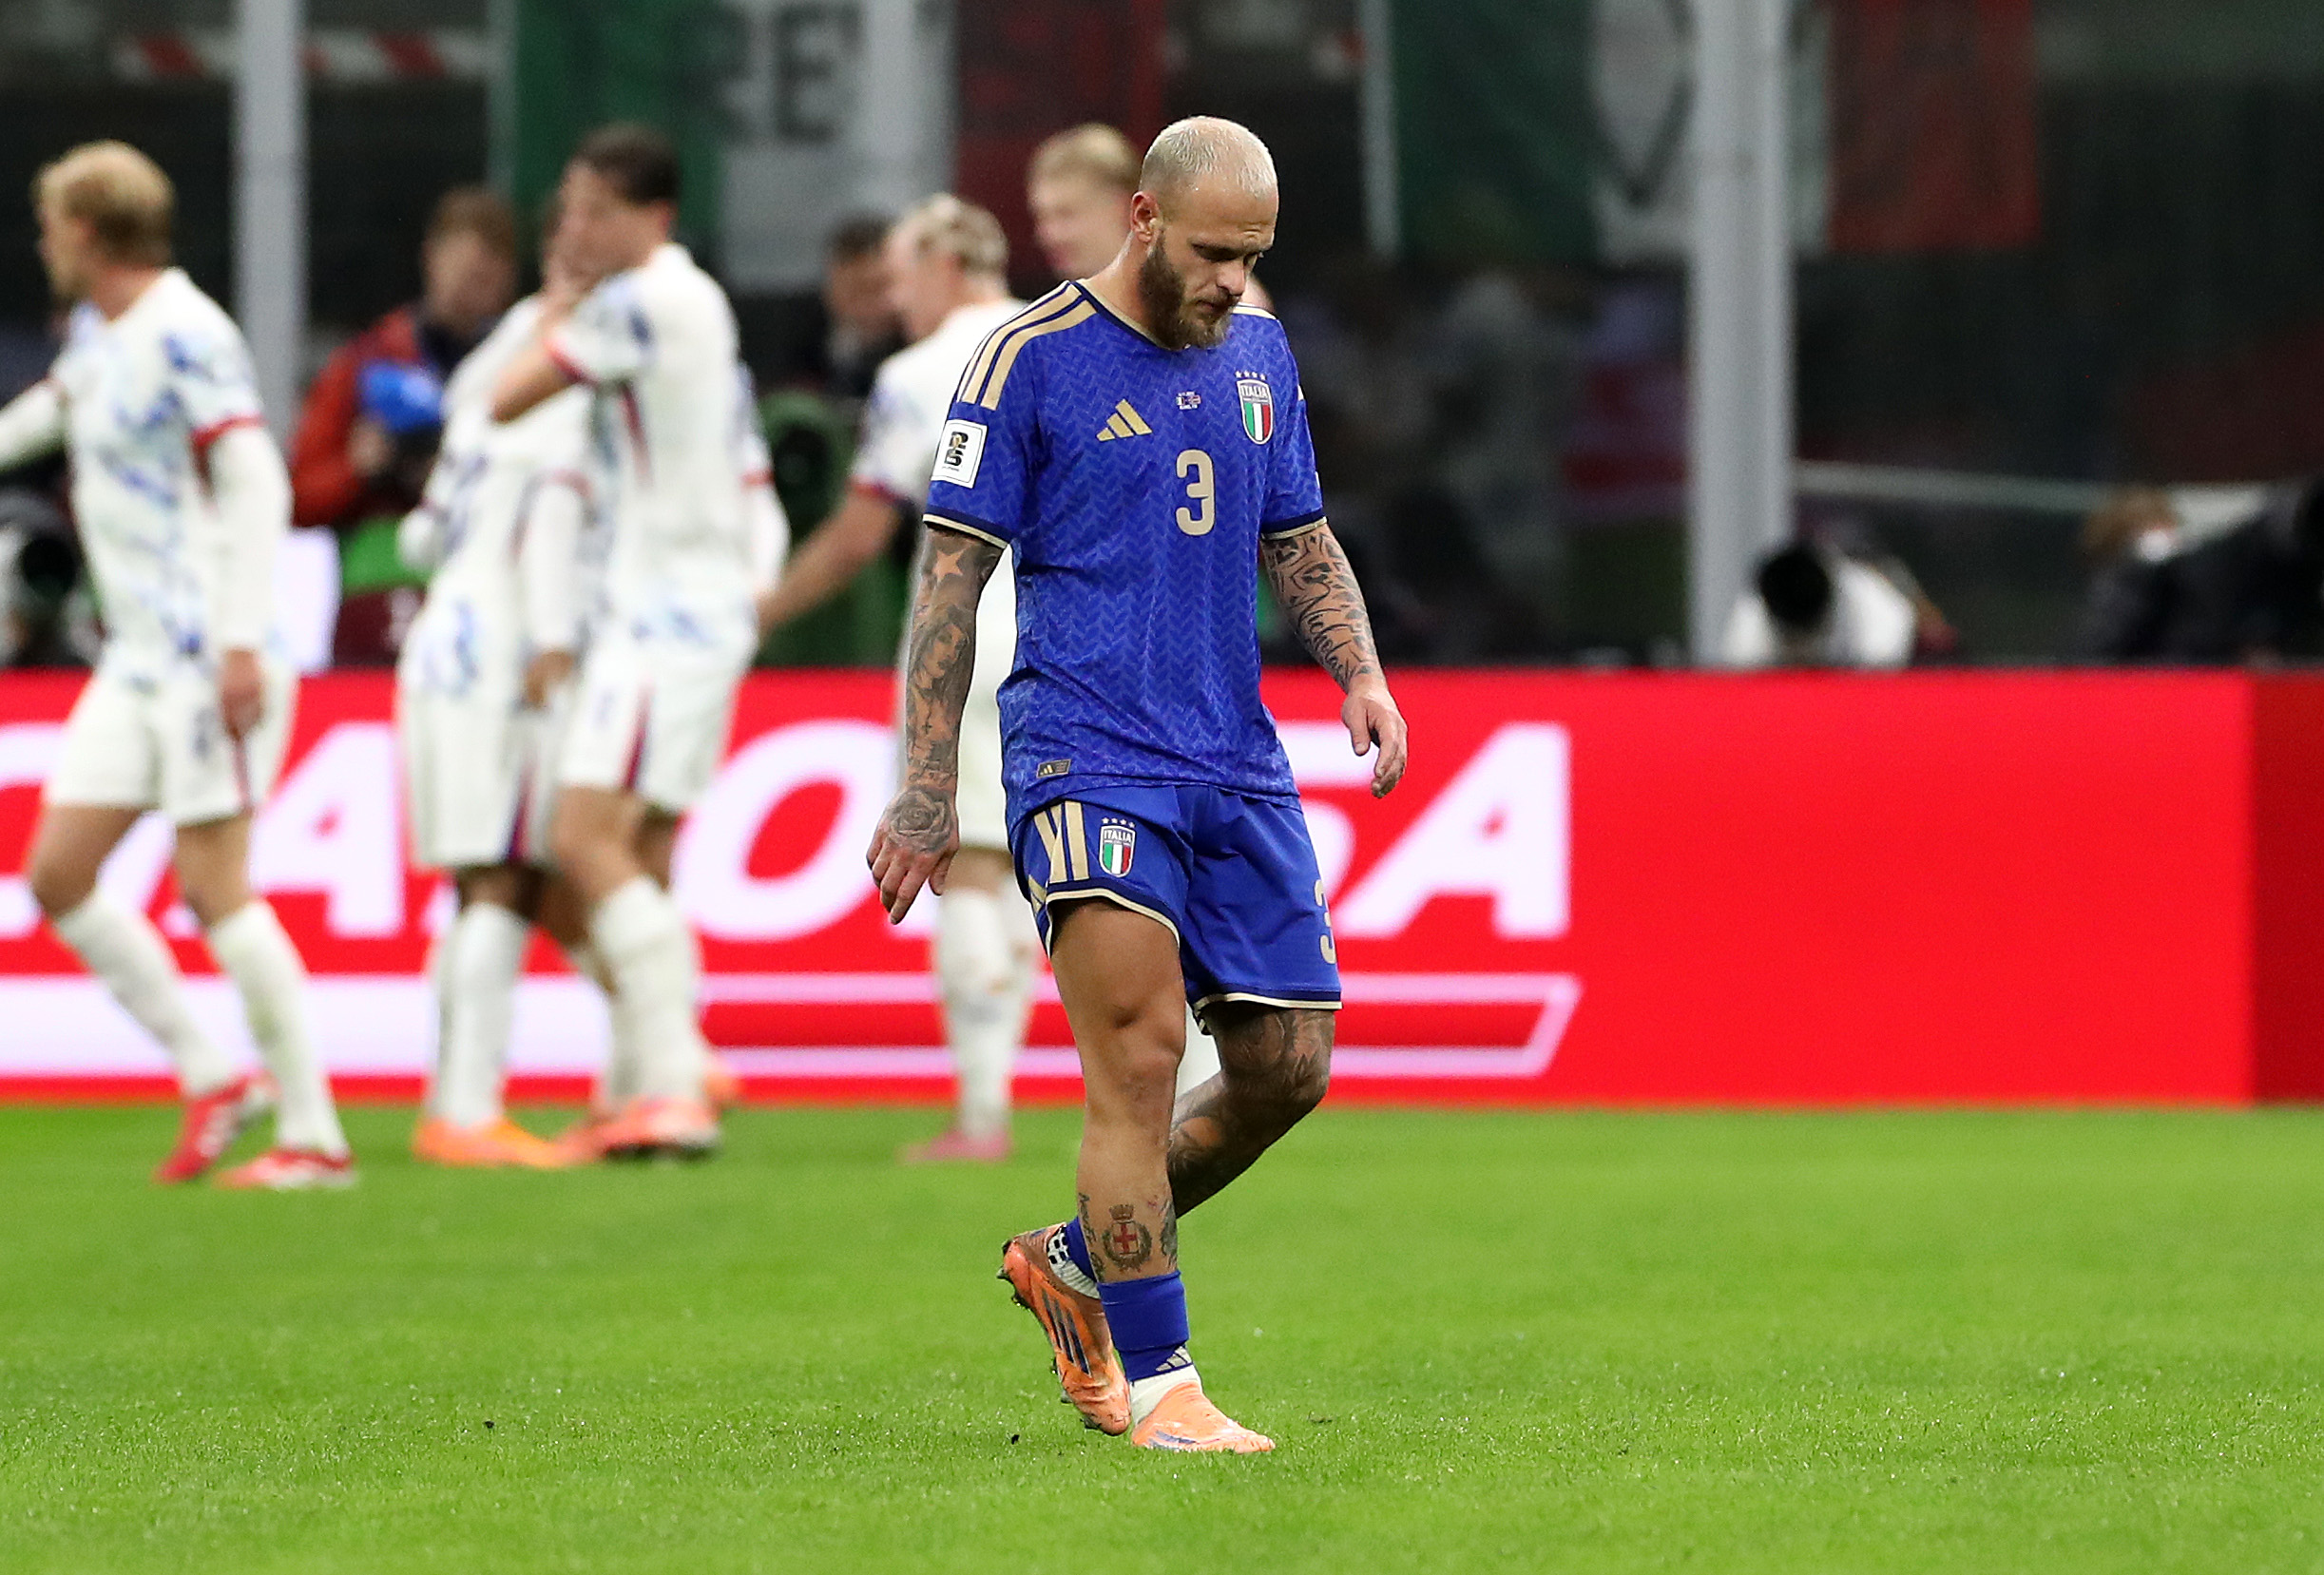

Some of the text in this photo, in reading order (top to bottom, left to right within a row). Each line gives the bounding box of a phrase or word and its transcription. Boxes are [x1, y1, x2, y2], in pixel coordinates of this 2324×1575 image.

[1240, 384, 1268, 398] ITALIA
[1176, 449, 1215, 536] 3
[1104, 830, 1132, 843] ITALIA
